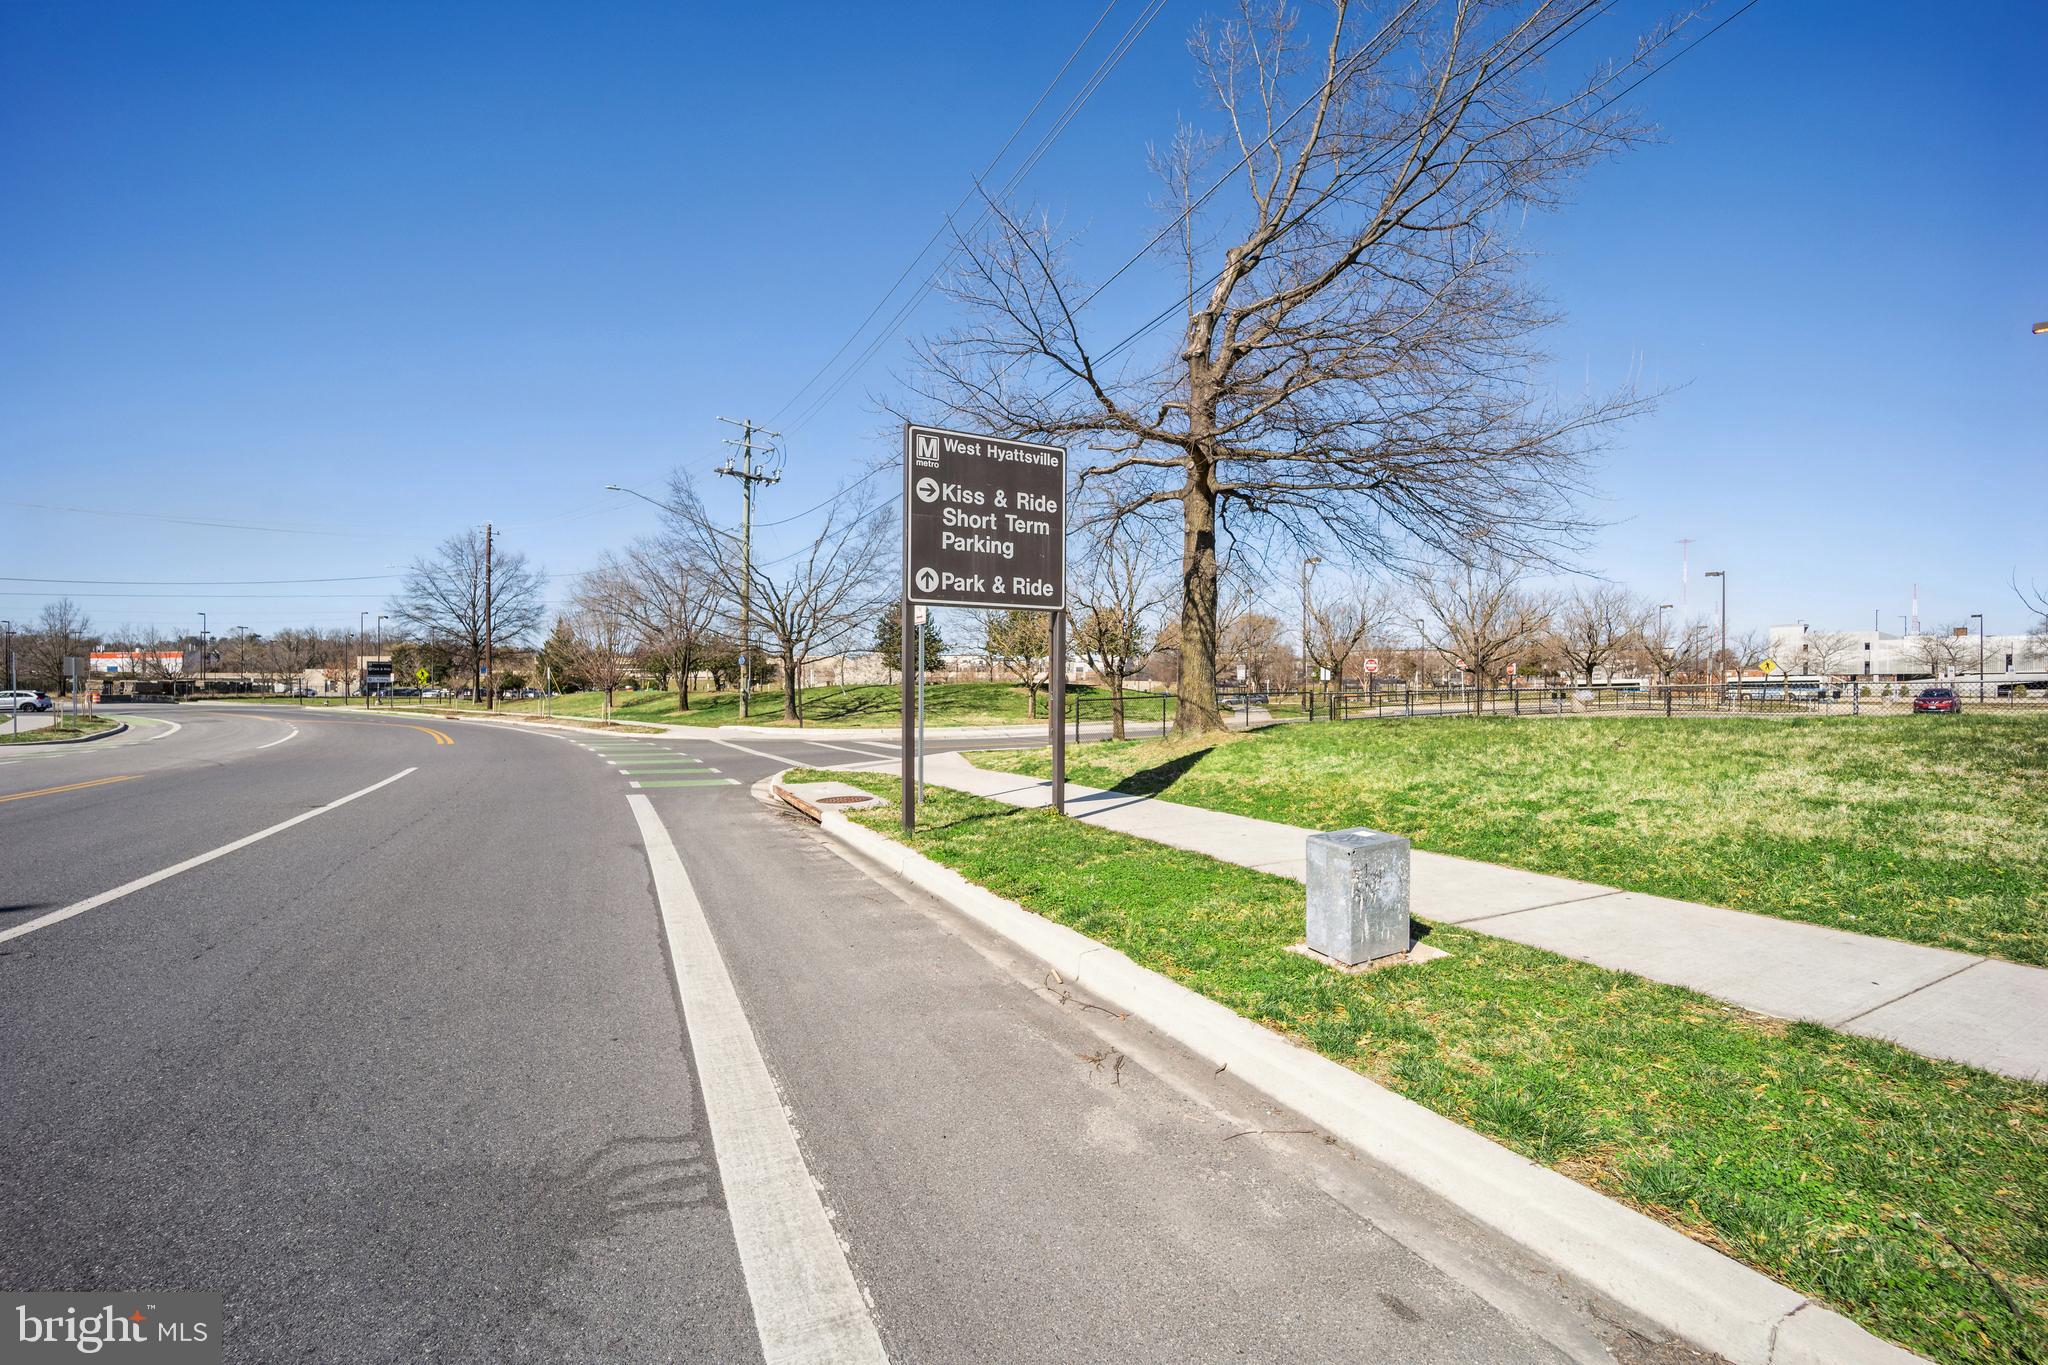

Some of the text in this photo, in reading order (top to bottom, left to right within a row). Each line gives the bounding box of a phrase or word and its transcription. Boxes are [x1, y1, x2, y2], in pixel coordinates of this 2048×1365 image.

[918, 436, 937, 459] M
[944, 437, 1059, 467] West Hyattsville
[916, 459, 940, 469] metro
[942, 482, 1058, 514] Kiss & Ride
[942, 507, 1050, 535] Short Term
[942, 531, 1014, 559] Parking
[941, 571, 1054, 597] Park & Ride
